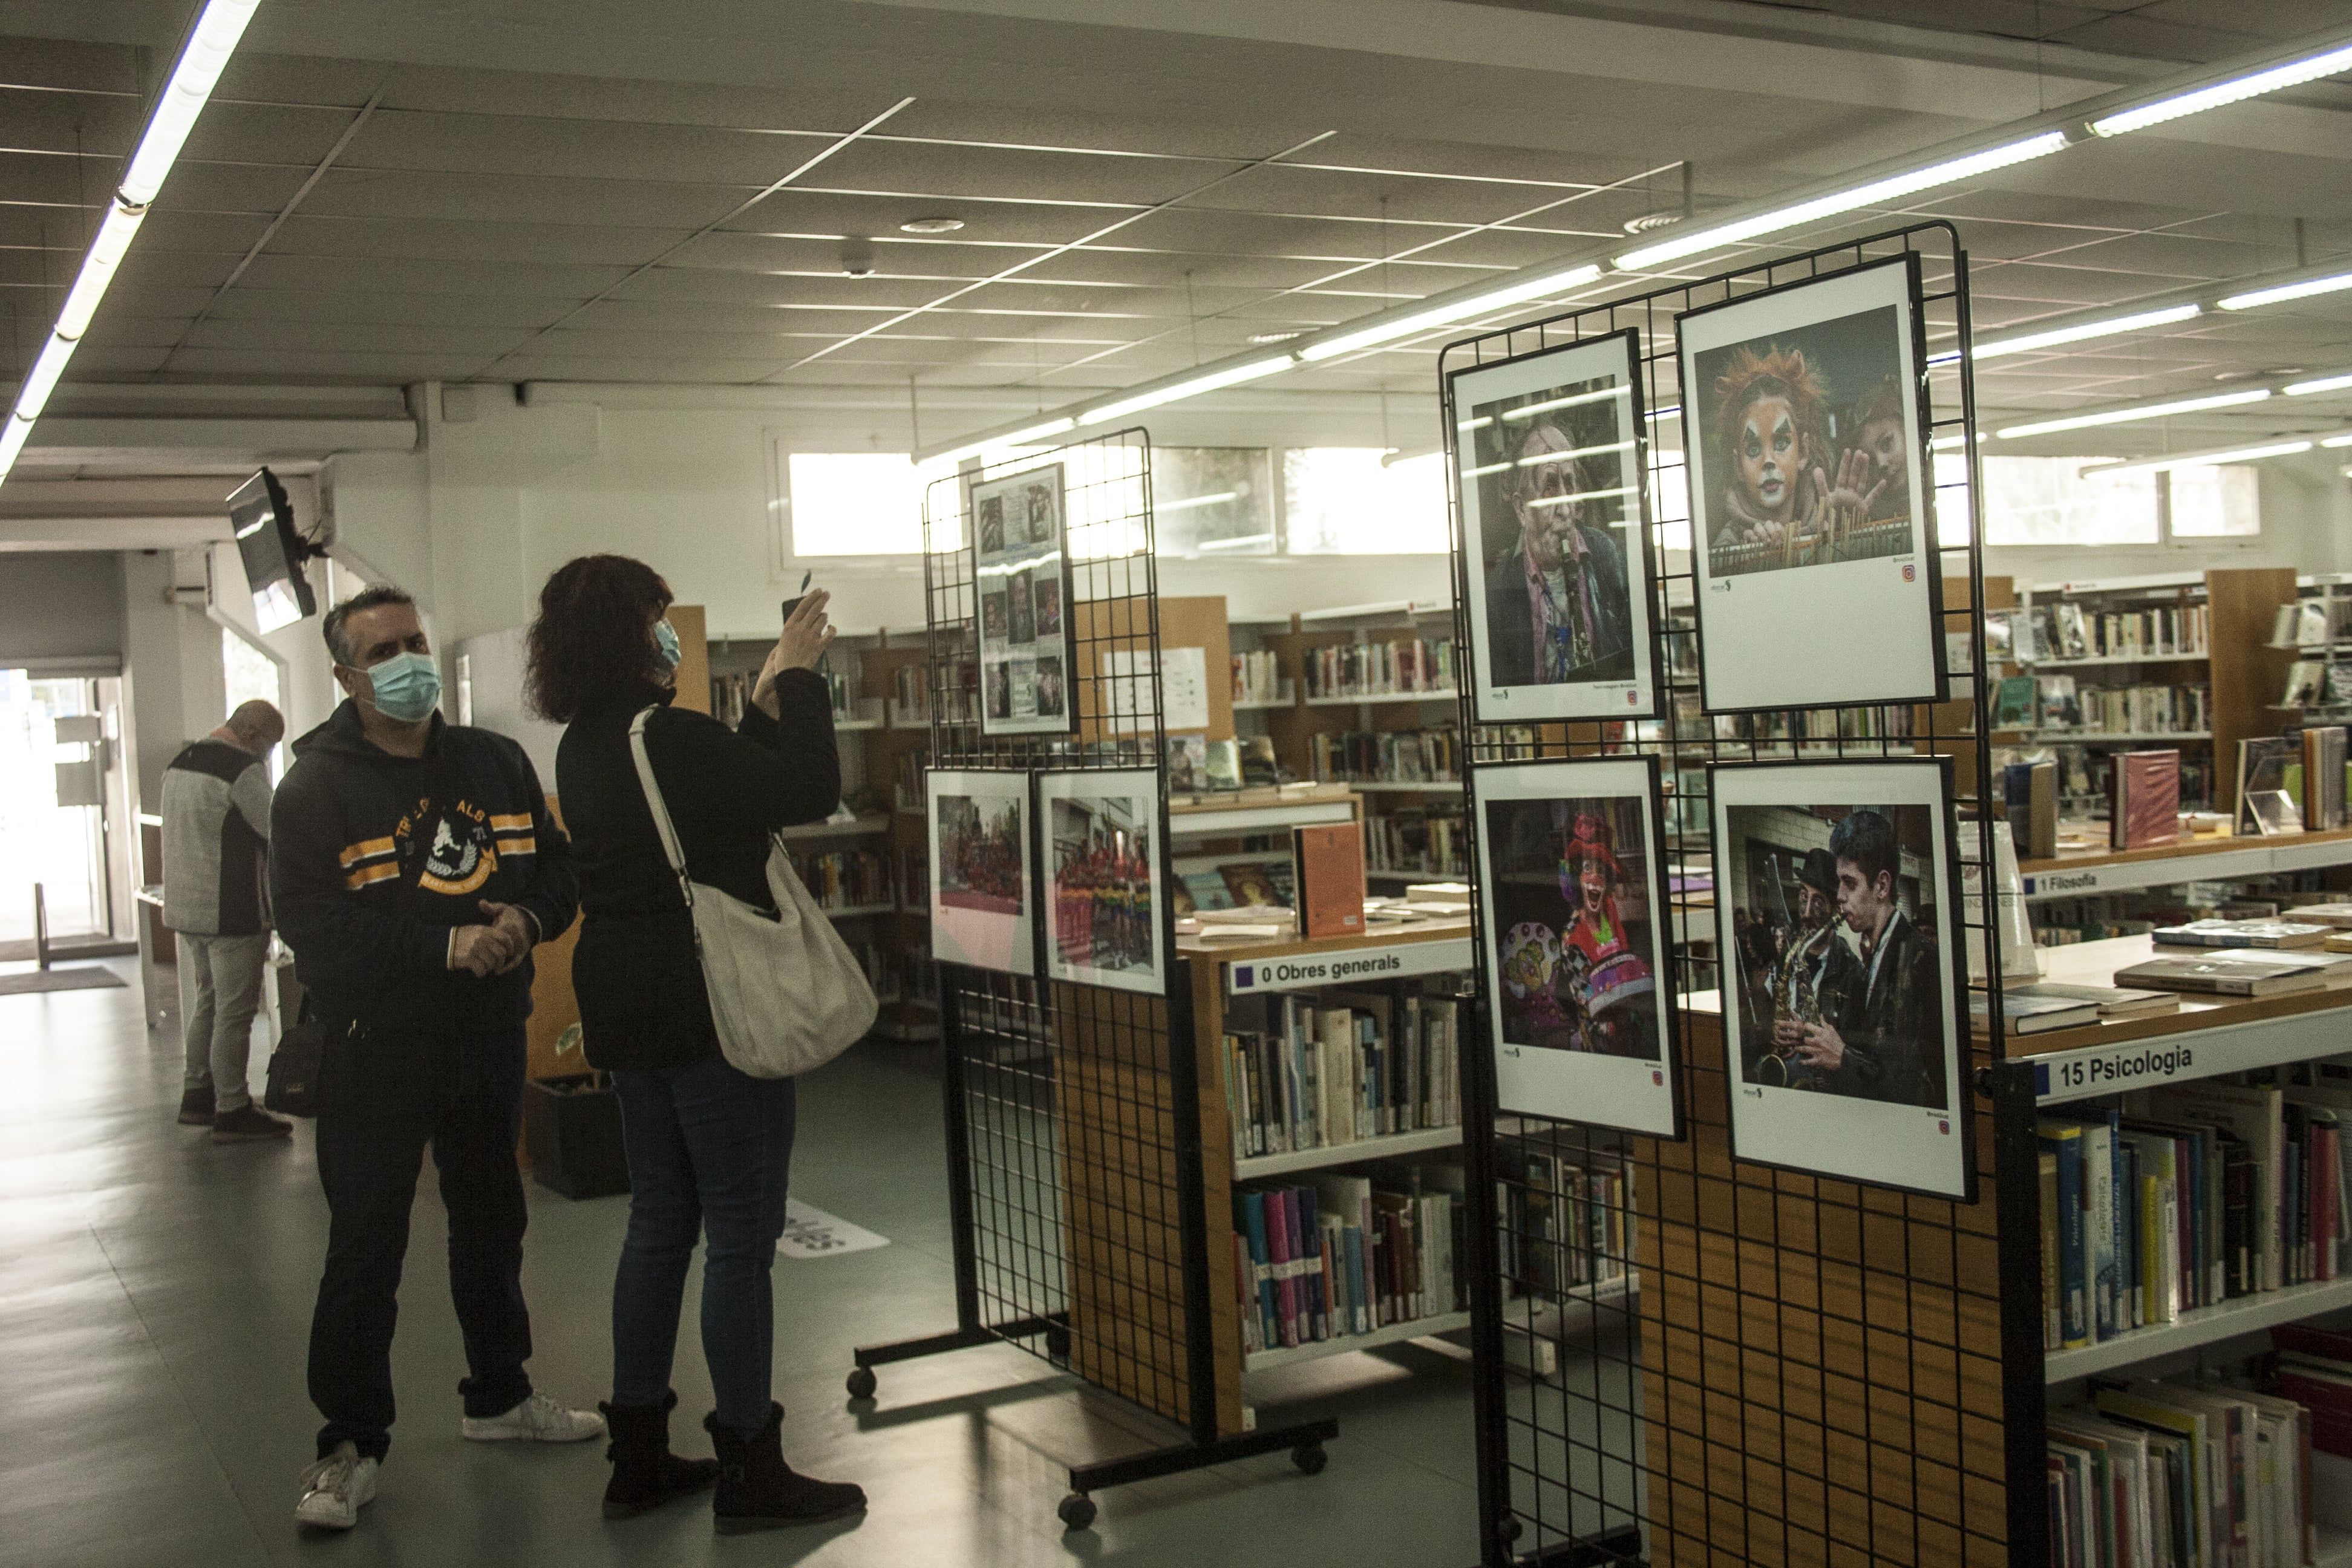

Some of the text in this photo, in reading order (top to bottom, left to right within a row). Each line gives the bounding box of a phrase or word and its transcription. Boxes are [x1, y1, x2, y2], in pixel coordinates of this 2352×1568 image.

[1261, 953, 1400, 983] 0 Obres generals
[2060, 1044, 2192, 1087] 15 Psicologia
